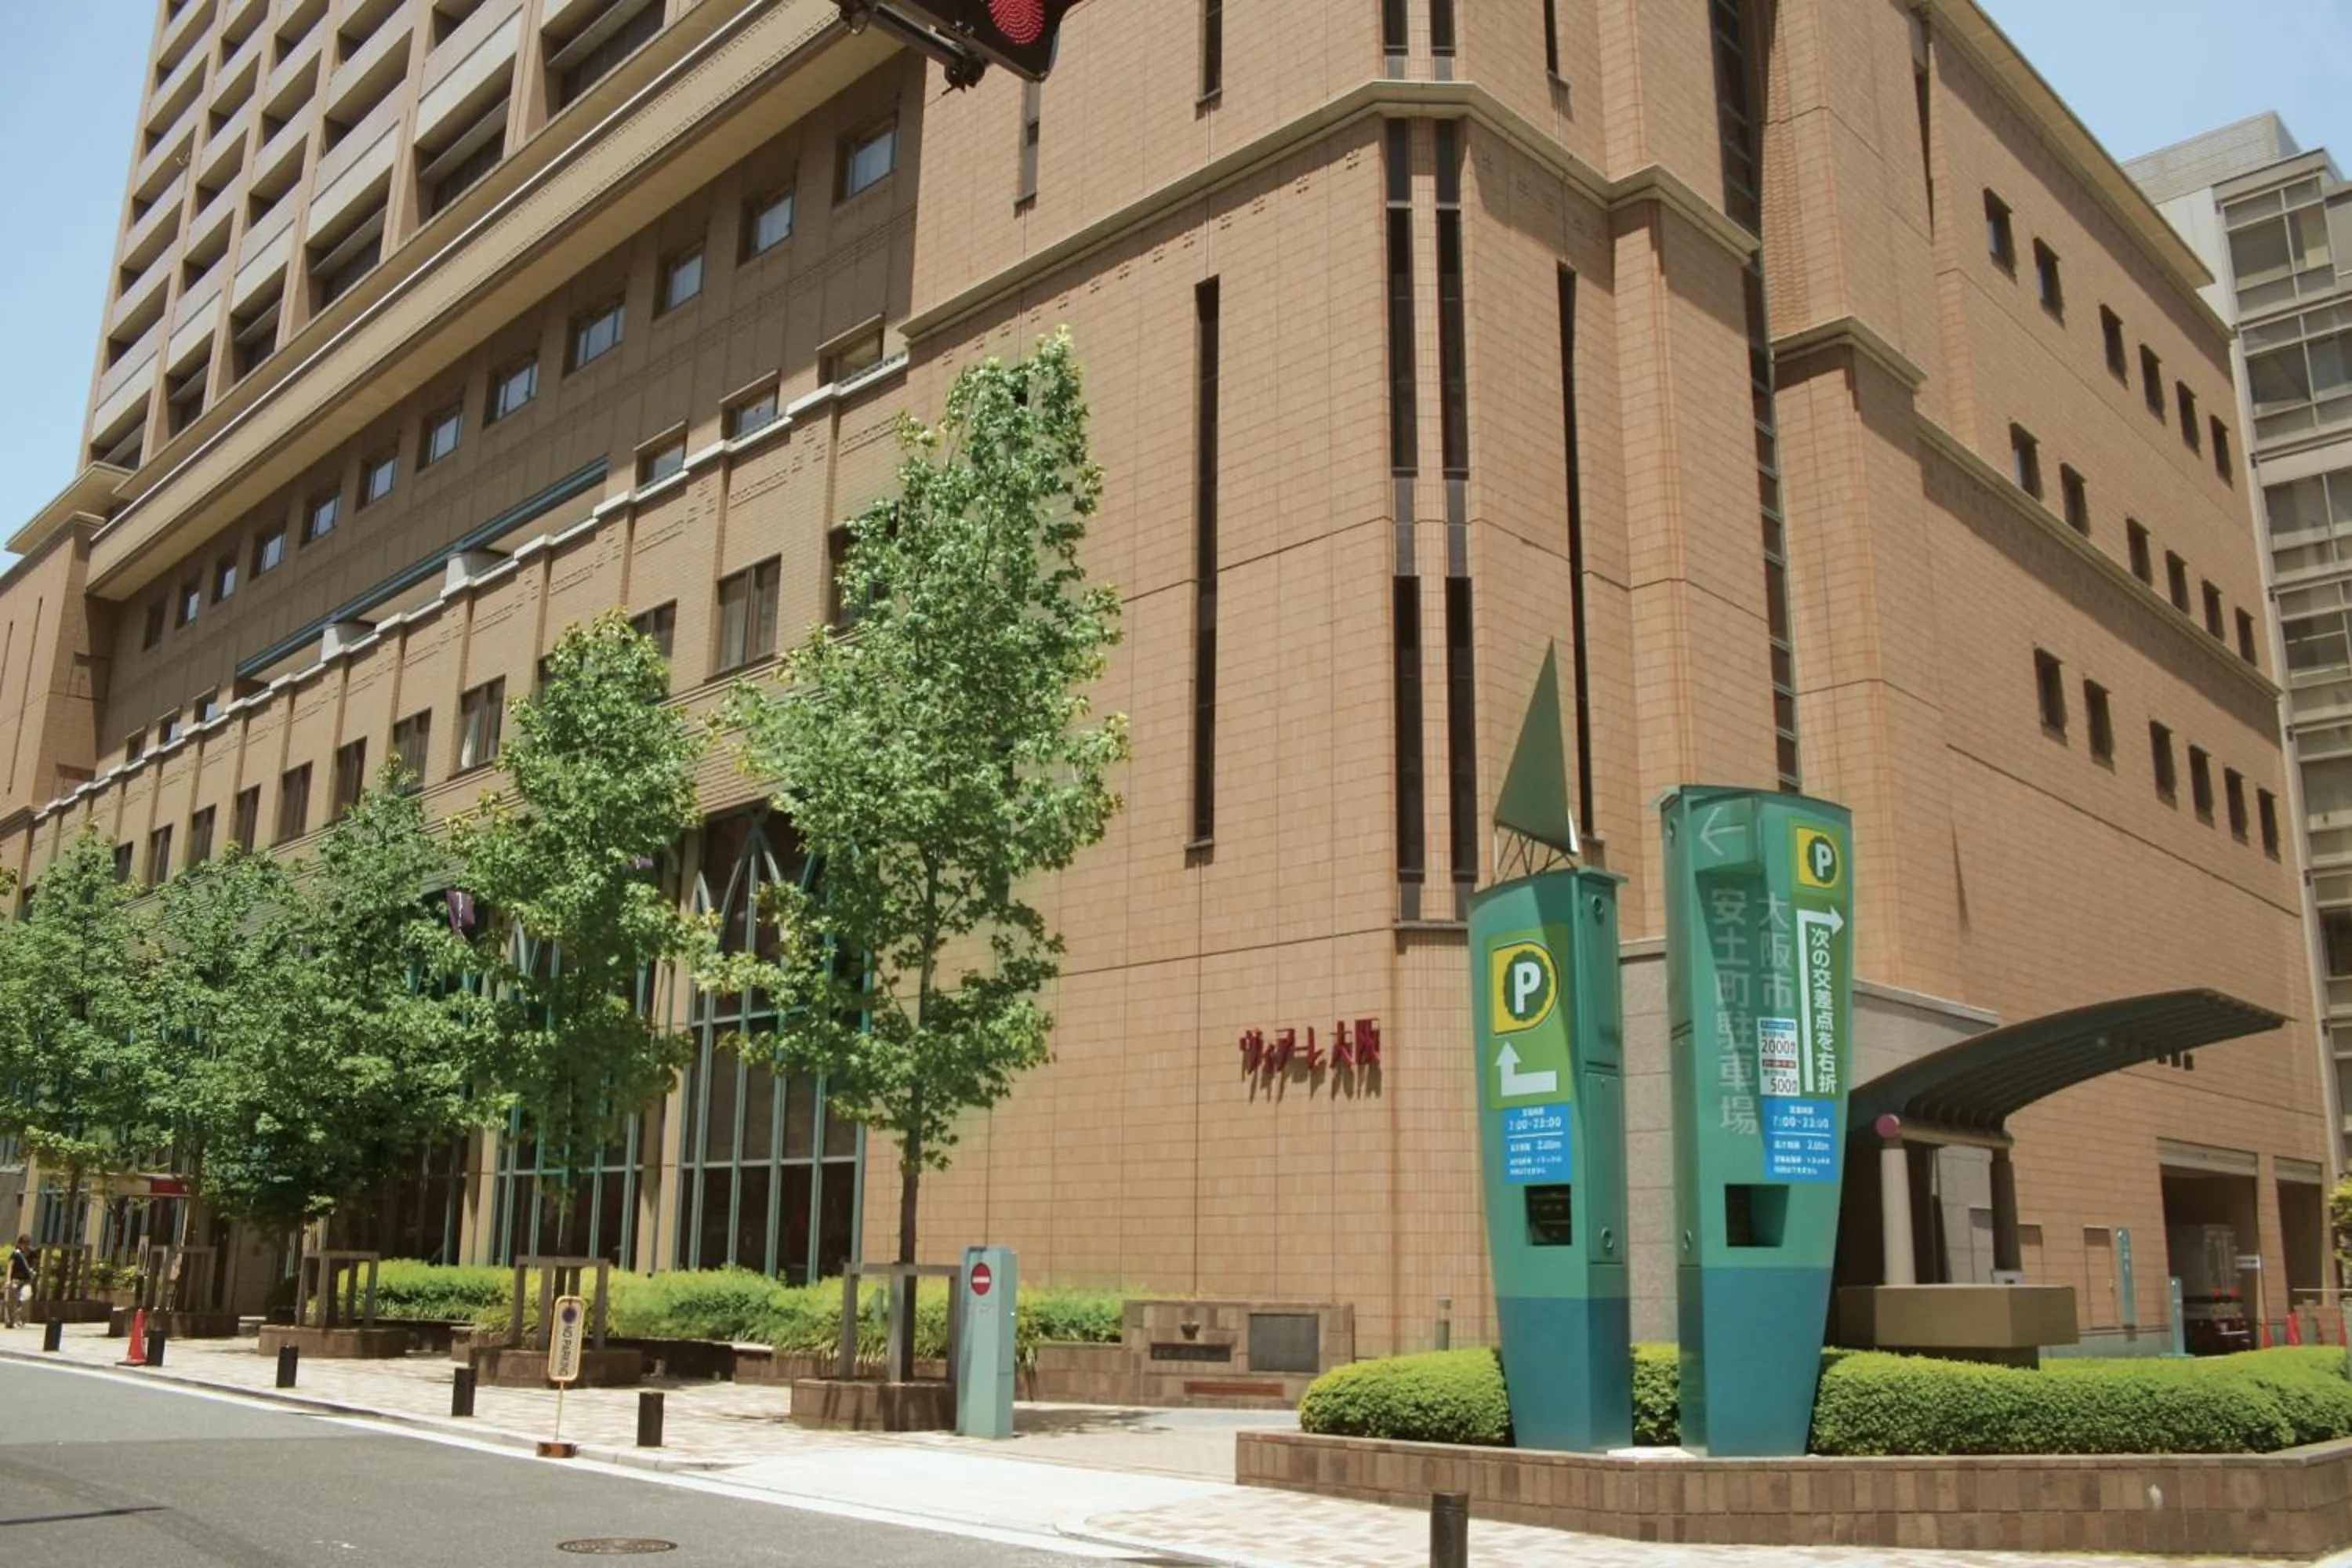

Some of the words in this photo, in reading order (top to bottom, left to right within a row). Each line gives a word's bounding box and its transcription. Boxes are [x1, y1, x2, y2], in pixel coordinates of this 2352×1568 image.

[1815, 843, 1833, 877] P
[1514, 961, 1541, 1014] P
[1755, 891, 1794, 1011] 大阪市
[1810, 927, 1837, 1094] 次の交差点を右折
[1711, 887, 1759, 1136] 安土町駐車場
